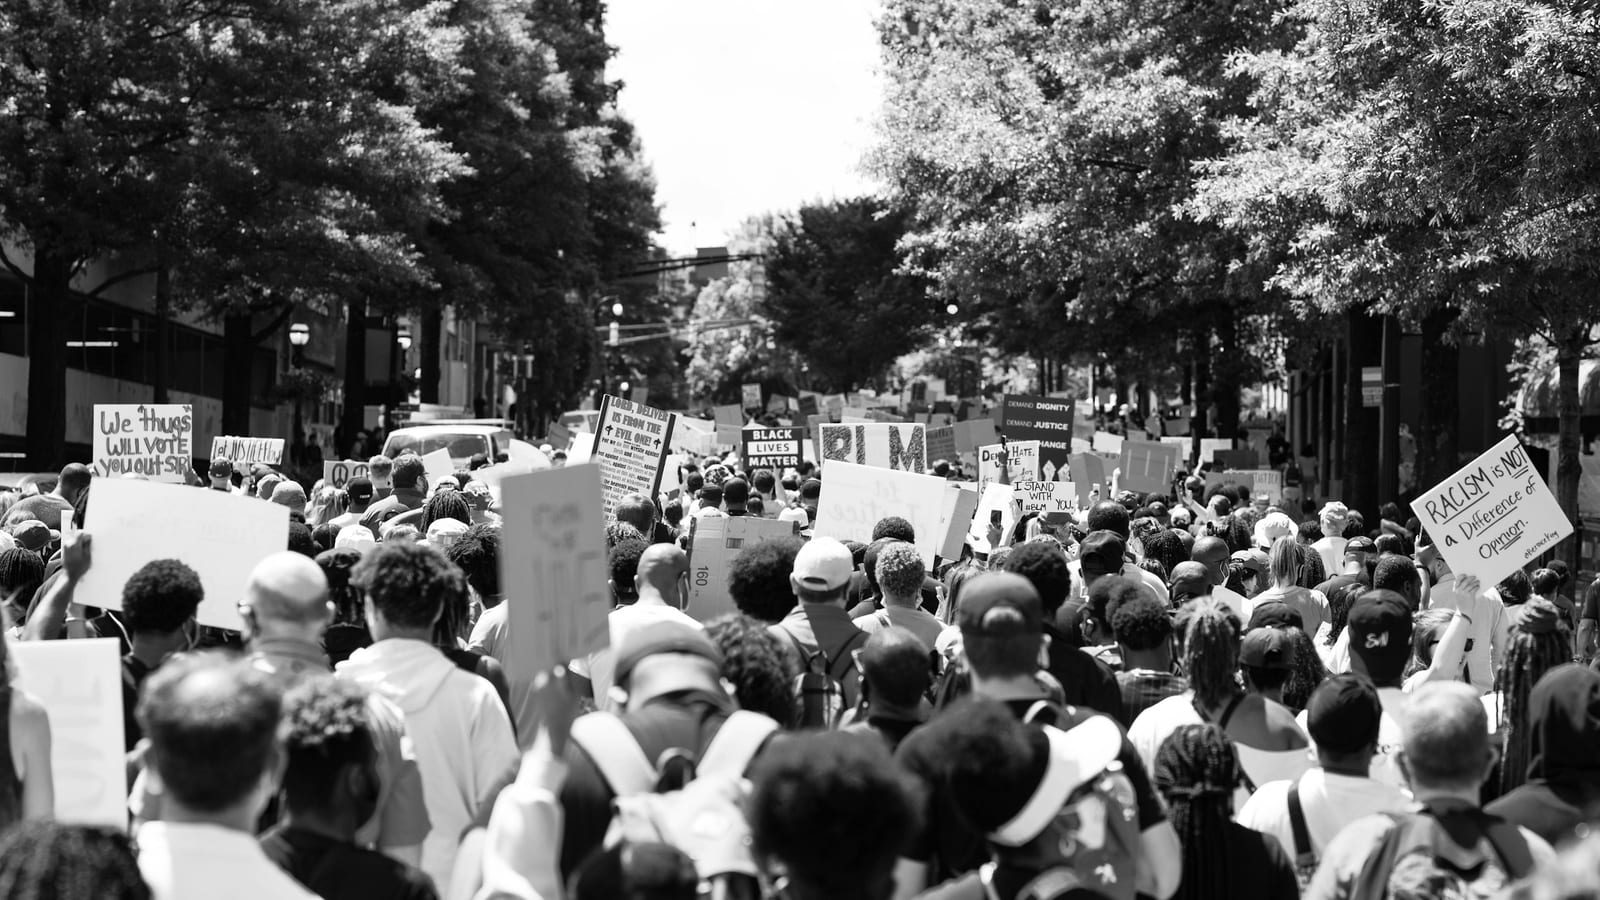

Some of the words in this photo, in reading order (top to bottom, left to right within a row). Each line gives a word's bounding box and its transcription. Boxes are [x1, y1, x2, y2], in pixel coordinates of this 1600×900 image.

[610, 396, 634, 414] LORD,
[637, 403, 668, 422] DELIVER
[1008, 400, 1034, 409] DEMAND
[1036, 402, 1070, 412] DIGNITY
[101, 411, 134, 435] We
[612, 412, 622, 423] US
[622, 414, 645, 430] FROM
[647, 422, 662, 435] THE
[1006, 419, 1032, 427] DEMAND
[1034, 422, 1069, 430] JUSTICE
[615, 427, 632, 441] EVIL
[634, 433, 652, 446] ONE!
[753, 430, 792, 440] BLACK
[106, 437, 142, 456] WILL
[144, 436, 188, 455] VOTE
[757, 443, 790, 452] LIVES
[1040, 440, 1067, 450] HANGE
[749, 456, 798, 466] MATTER
[1014, 482, 1022, 491] I
[1024, 482, 1054, 492] STAND
[1425, 466, 1494, 524] RACISM
[1490, 466, 1504, 479] is
[1500, 443, 1528, 476] NOT
[1029, 492, 1051, 500] WITH
[1056, 499, 1074, 510] YOU.
[1445, 534, 1458, 547] a
[1459, 490, 1522, 540] Difference
[1525, 475, 1536, 495] of
[1478, 520, 1528, 559] Opinion.
[696, 566, 709, 586] 160
